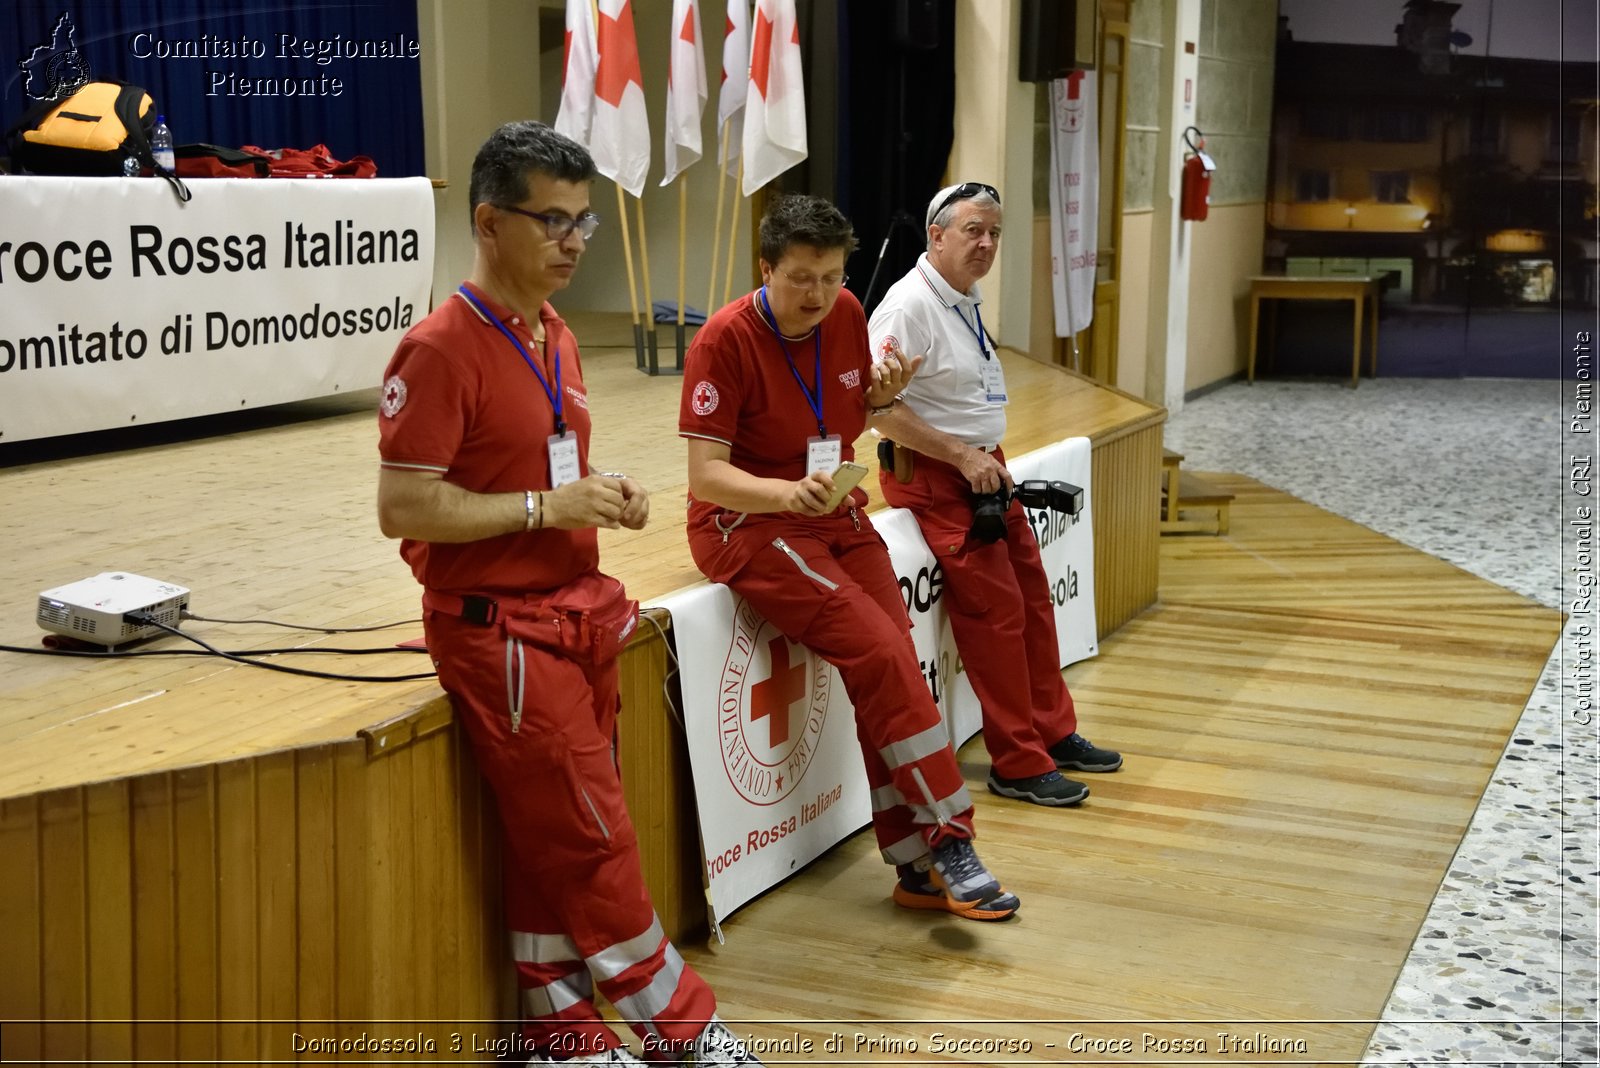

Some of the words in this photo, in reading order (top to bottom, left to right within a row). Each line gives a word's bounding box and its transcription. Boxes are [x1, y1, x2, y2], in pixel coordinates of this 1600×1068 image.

[0, 240, 112, 283] roce
[130, 224, 267, 278] Rossa
[284, 219, 419, 269] Italiana
[0, 321, 148, 372] omitato
[160, 314, 193, 355] di
[205, 296, 413, 351] Domodossola
[736, 624, 752, 656] DI
[721, 660, 772, 798] CONVENZIONE
[788, 737, 812, 783] 1864
[746, 815, 797, 855] Rossa
[800, 783, 842, 826] Italiana
